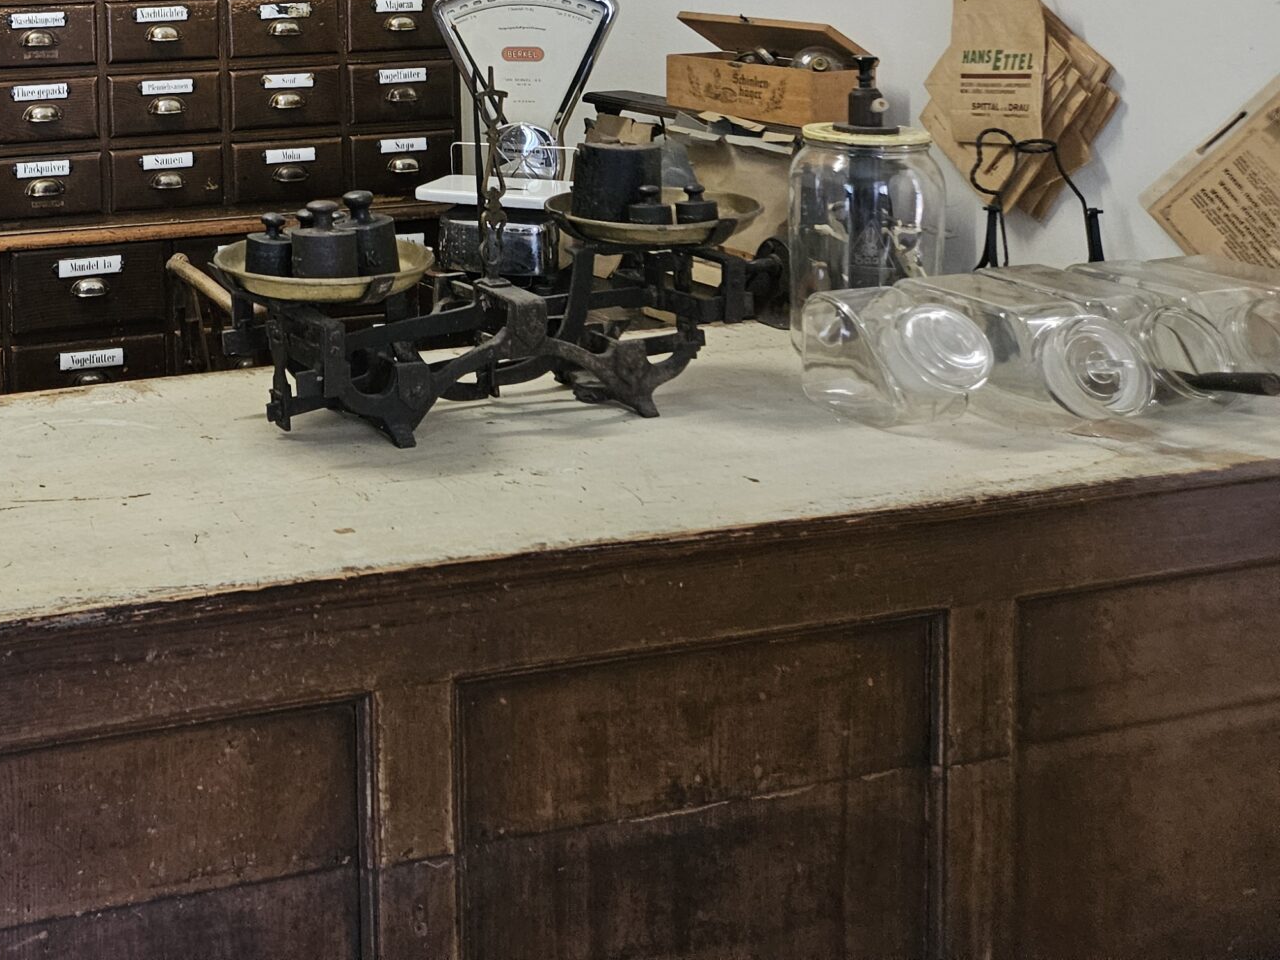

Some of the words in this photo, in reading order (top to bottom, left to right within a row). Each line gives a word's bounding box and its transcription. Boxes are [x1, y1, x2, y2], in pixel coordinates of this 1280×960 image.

[385, 0, 414, 10] Majoran
[139, 7, 185, 19] Nachtlichter
[507, 49, 538, 58] BERKEL
[962, 49, 992, 64] HANS
[992, 49, 1033, 71] ETTEL
[380, 70, 421, 81] Vogelfutter
[971, 102, 1000, 112] SPITTAL
[1008, 103, 1030, 112] DRAU
[395, 141, 415, 151] Sago
[154, 156, 184, 166] Samen
[70, 260, 100, 271] Mandel
[70, 355, 117, 367] Vogelfutter
